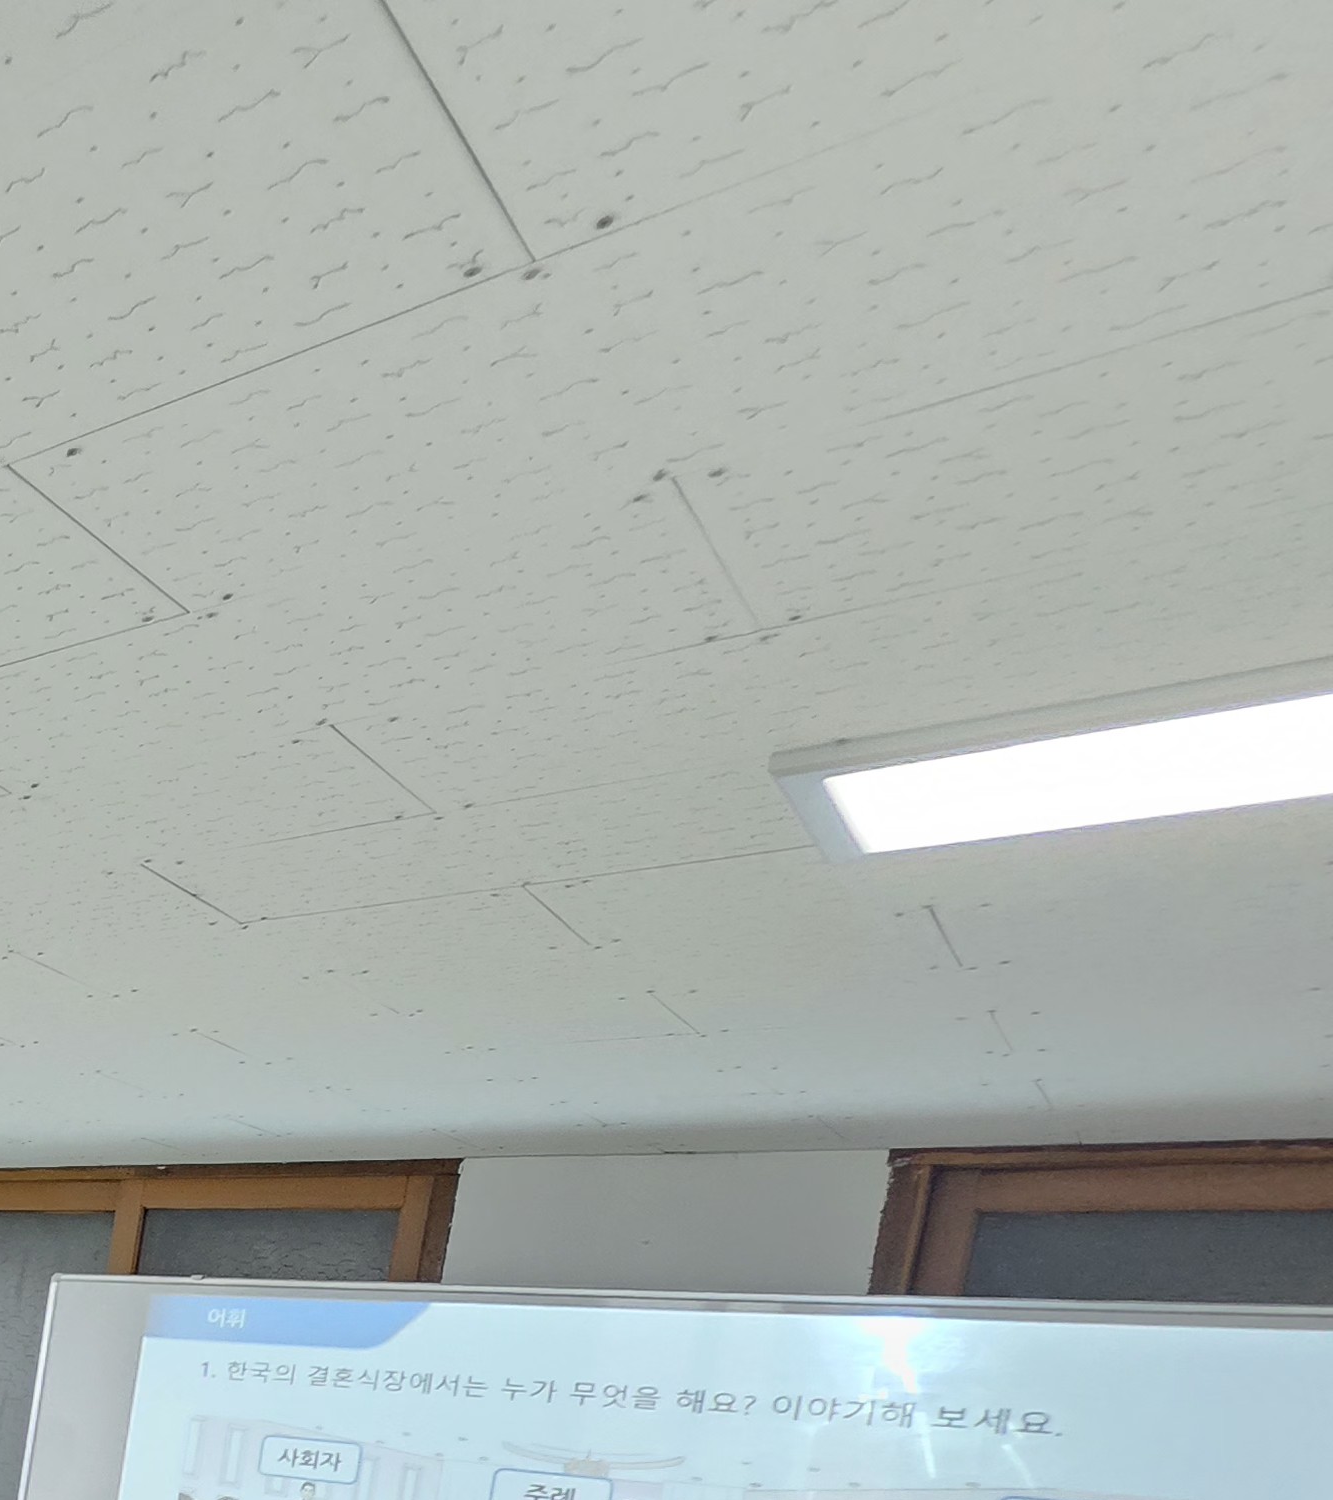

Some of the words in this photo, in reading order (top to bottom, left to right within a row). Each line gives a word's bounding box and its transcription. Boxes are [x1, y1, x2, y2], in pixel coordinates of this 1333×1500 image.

[207, 1307, 247, 1330] 어휘
[199, 1361, 217, 1379] 1.
[227, 1360, 297, 1386] 한국의
[306, 1365, 489, 1399] 결혼식장에서는
[500, 1377, 558, 1404] 누가
[568, 1380, 662, 1411] 무엇을
[676, 1388, 757, 1416] 해요?
[772, 1394, 917, 1429] 이야기해
[931, 1405, 1064, 1437] 보세요.
[277, 1448, 343, 1472] 사회자
